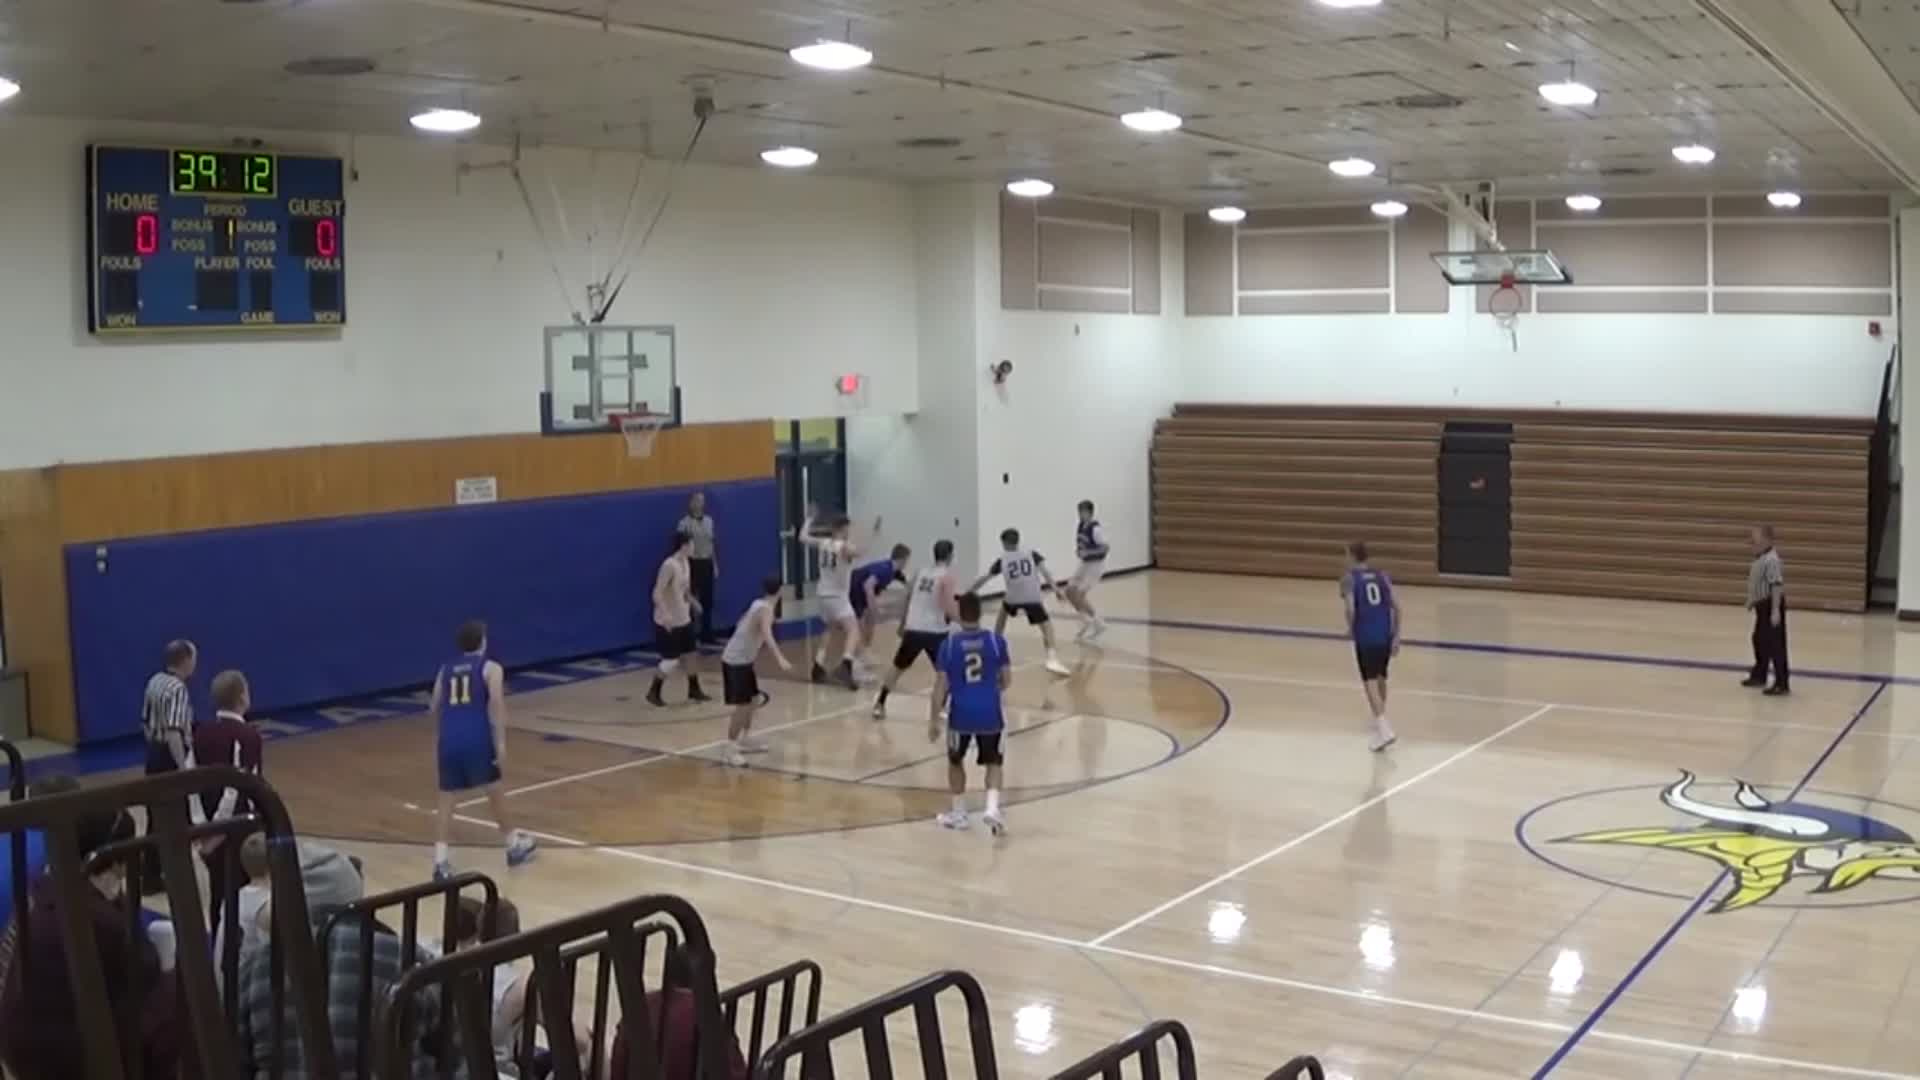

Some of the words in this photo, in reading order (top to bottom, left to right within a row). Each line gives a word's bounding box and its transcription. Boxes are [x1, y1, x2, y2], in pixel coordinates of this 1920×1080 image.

[106, 193, 158, 211] HOME
[288, 198, 342, 216] GUEST
[203, 204, 247, 217] PERIOD
[172, 219, 214, 232] BONUS
[237, 221, 276, 233] BONUS
[136, 214, 156, 253] 0
[316, 219, 336, 256] 0
[172, 238, 206, 252] POSS
[244, 240, 276, 253] POSS
[101, 256, 142, 270] FOULS
[195, 256, 239, 271] PLAYER
[246, 256, 276, 271] FOUL
[305, 257, 341, 271] FOULS
[241, 312, 275, 324] GAME
[1007, 558, 1032, 578] 20
[1365, 582, 1381, 606] 0
[964, 653, 983, 683] 2
[450, 676, 470, 705] 11
